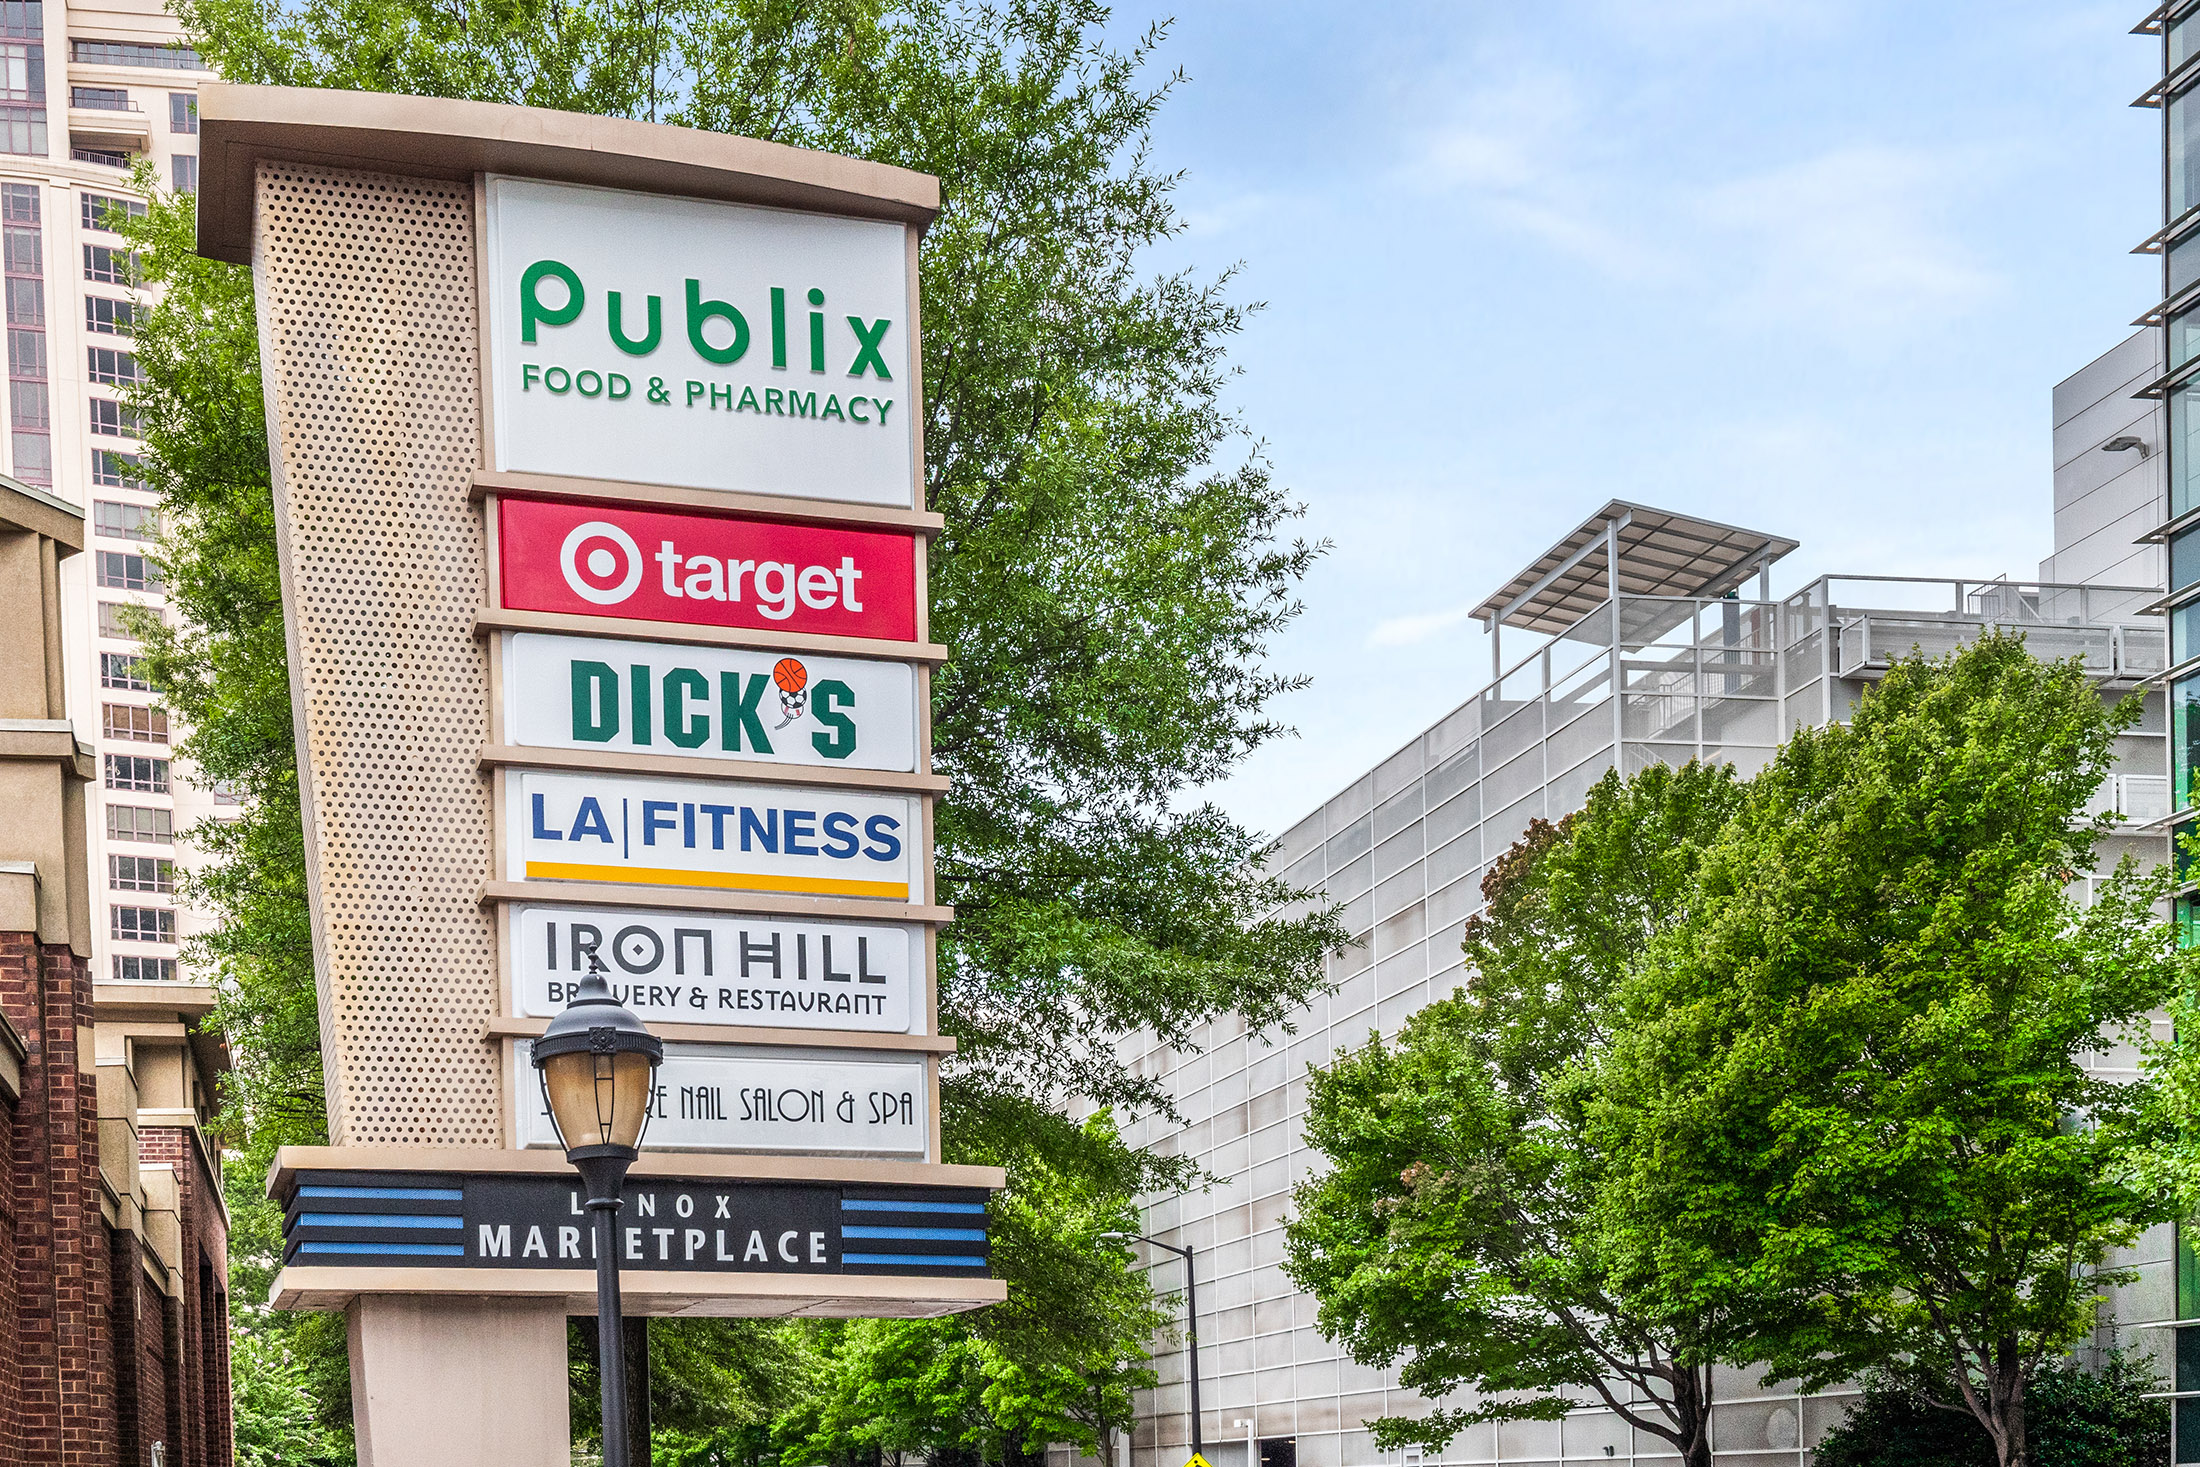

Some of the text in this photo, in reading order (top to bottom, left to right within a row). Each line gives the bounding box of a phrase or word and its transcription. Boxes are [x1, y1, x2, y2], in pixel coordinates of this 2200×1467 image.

[519, 259, 894, 381] Publix
[521, 363, 894, 426] FOOD & PHARMACY
[655, 540, 863, 621] target
[570, 657, 857, 760] DICK'S
[546, 921, 887, 984] IRON HILL
[547, 981, 888, 1016] BRERY & RESTAURANT
[680, 1085, 728, 1120] NAIL
[740, 1087, 824, 1123] SALON
[835, 1091, 856, 1124] &
[868, 1091, 914, 1126] SPA
[571, 1191, 731, 1219] LNOX
